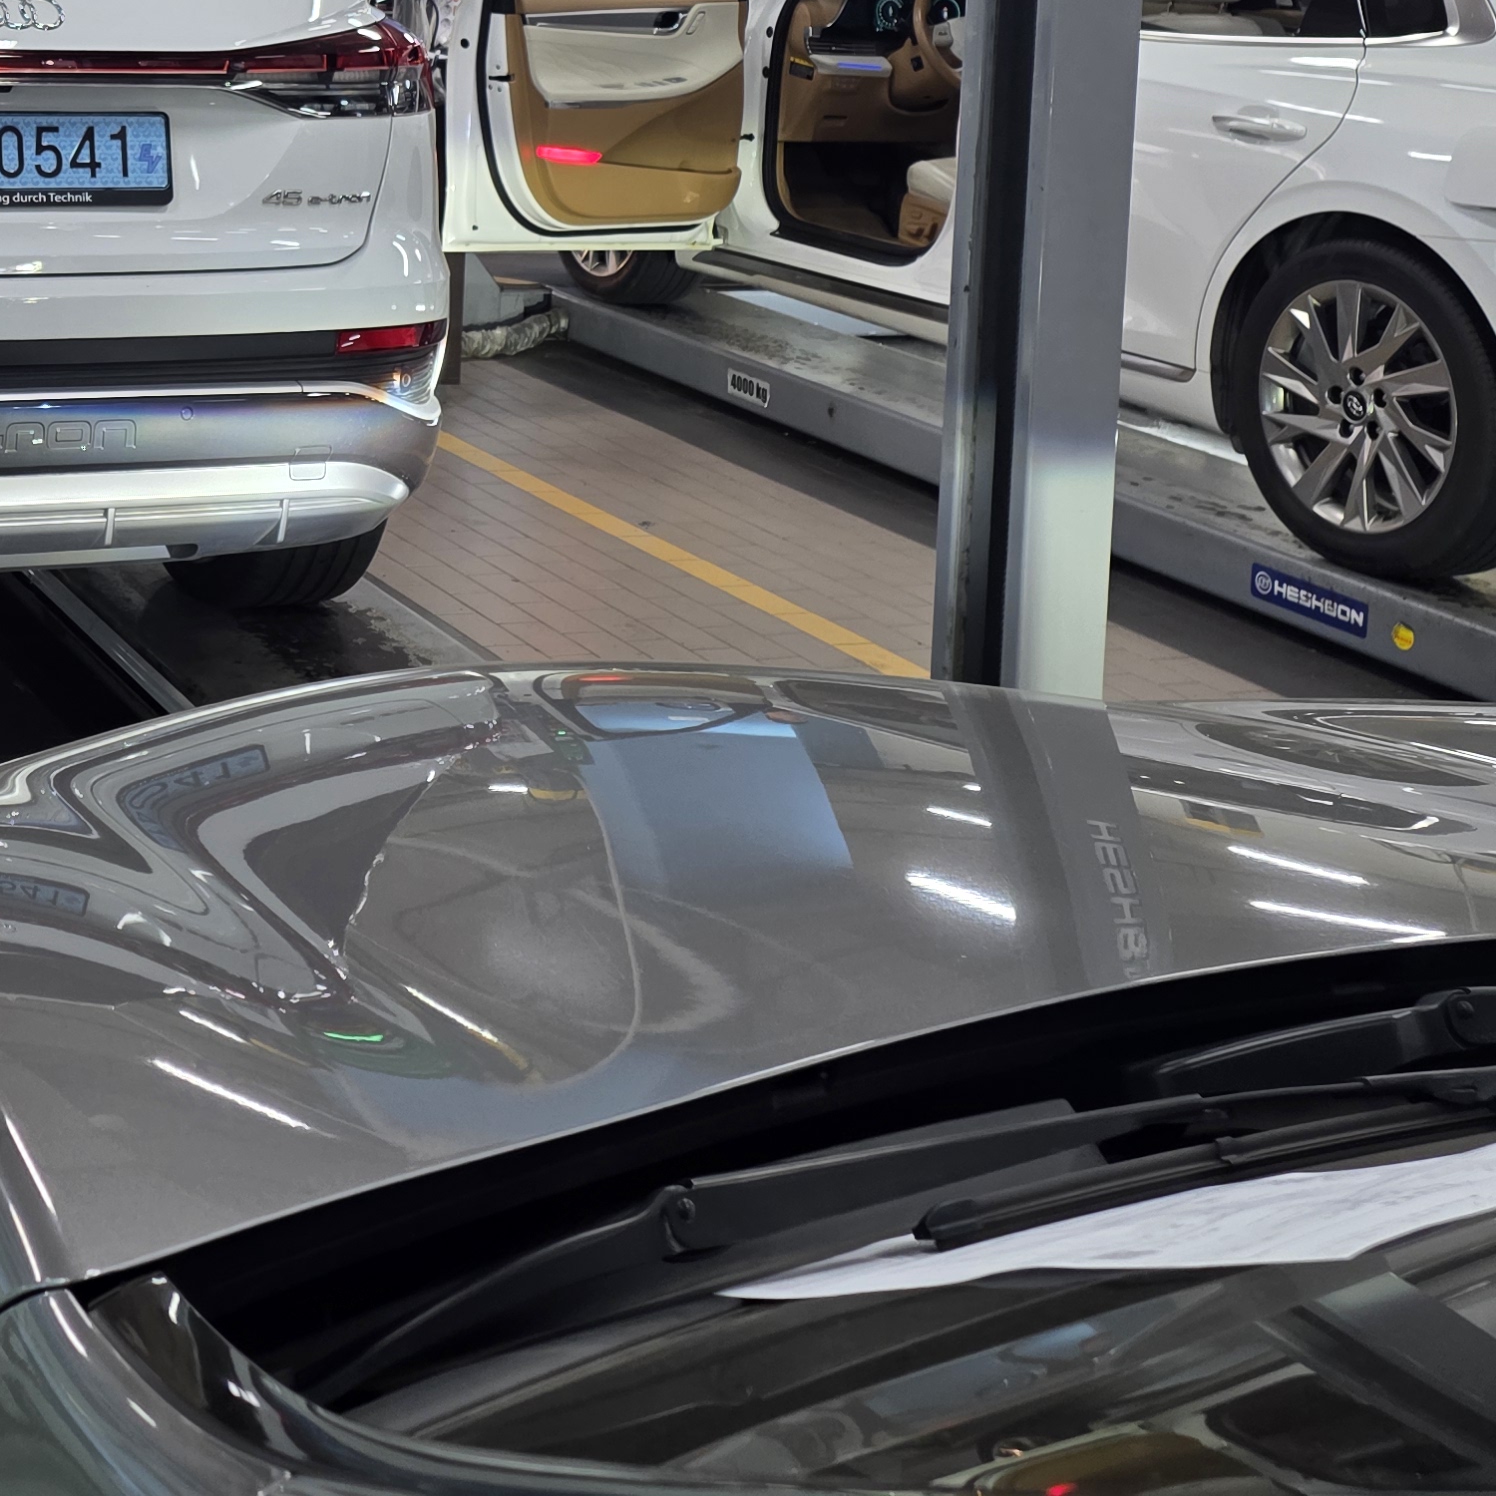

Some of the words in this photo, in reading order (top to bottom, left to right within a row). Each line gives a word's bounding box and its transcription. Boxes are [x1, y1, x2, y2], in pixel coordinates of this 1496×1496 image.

[12, 192, 47, 203] durch
[48, 192, 93, 203] Technik
[263, 189, 302, 206] 45
[731, 374, 754, 396] 4000
[756, 382, 767, 404] kg
